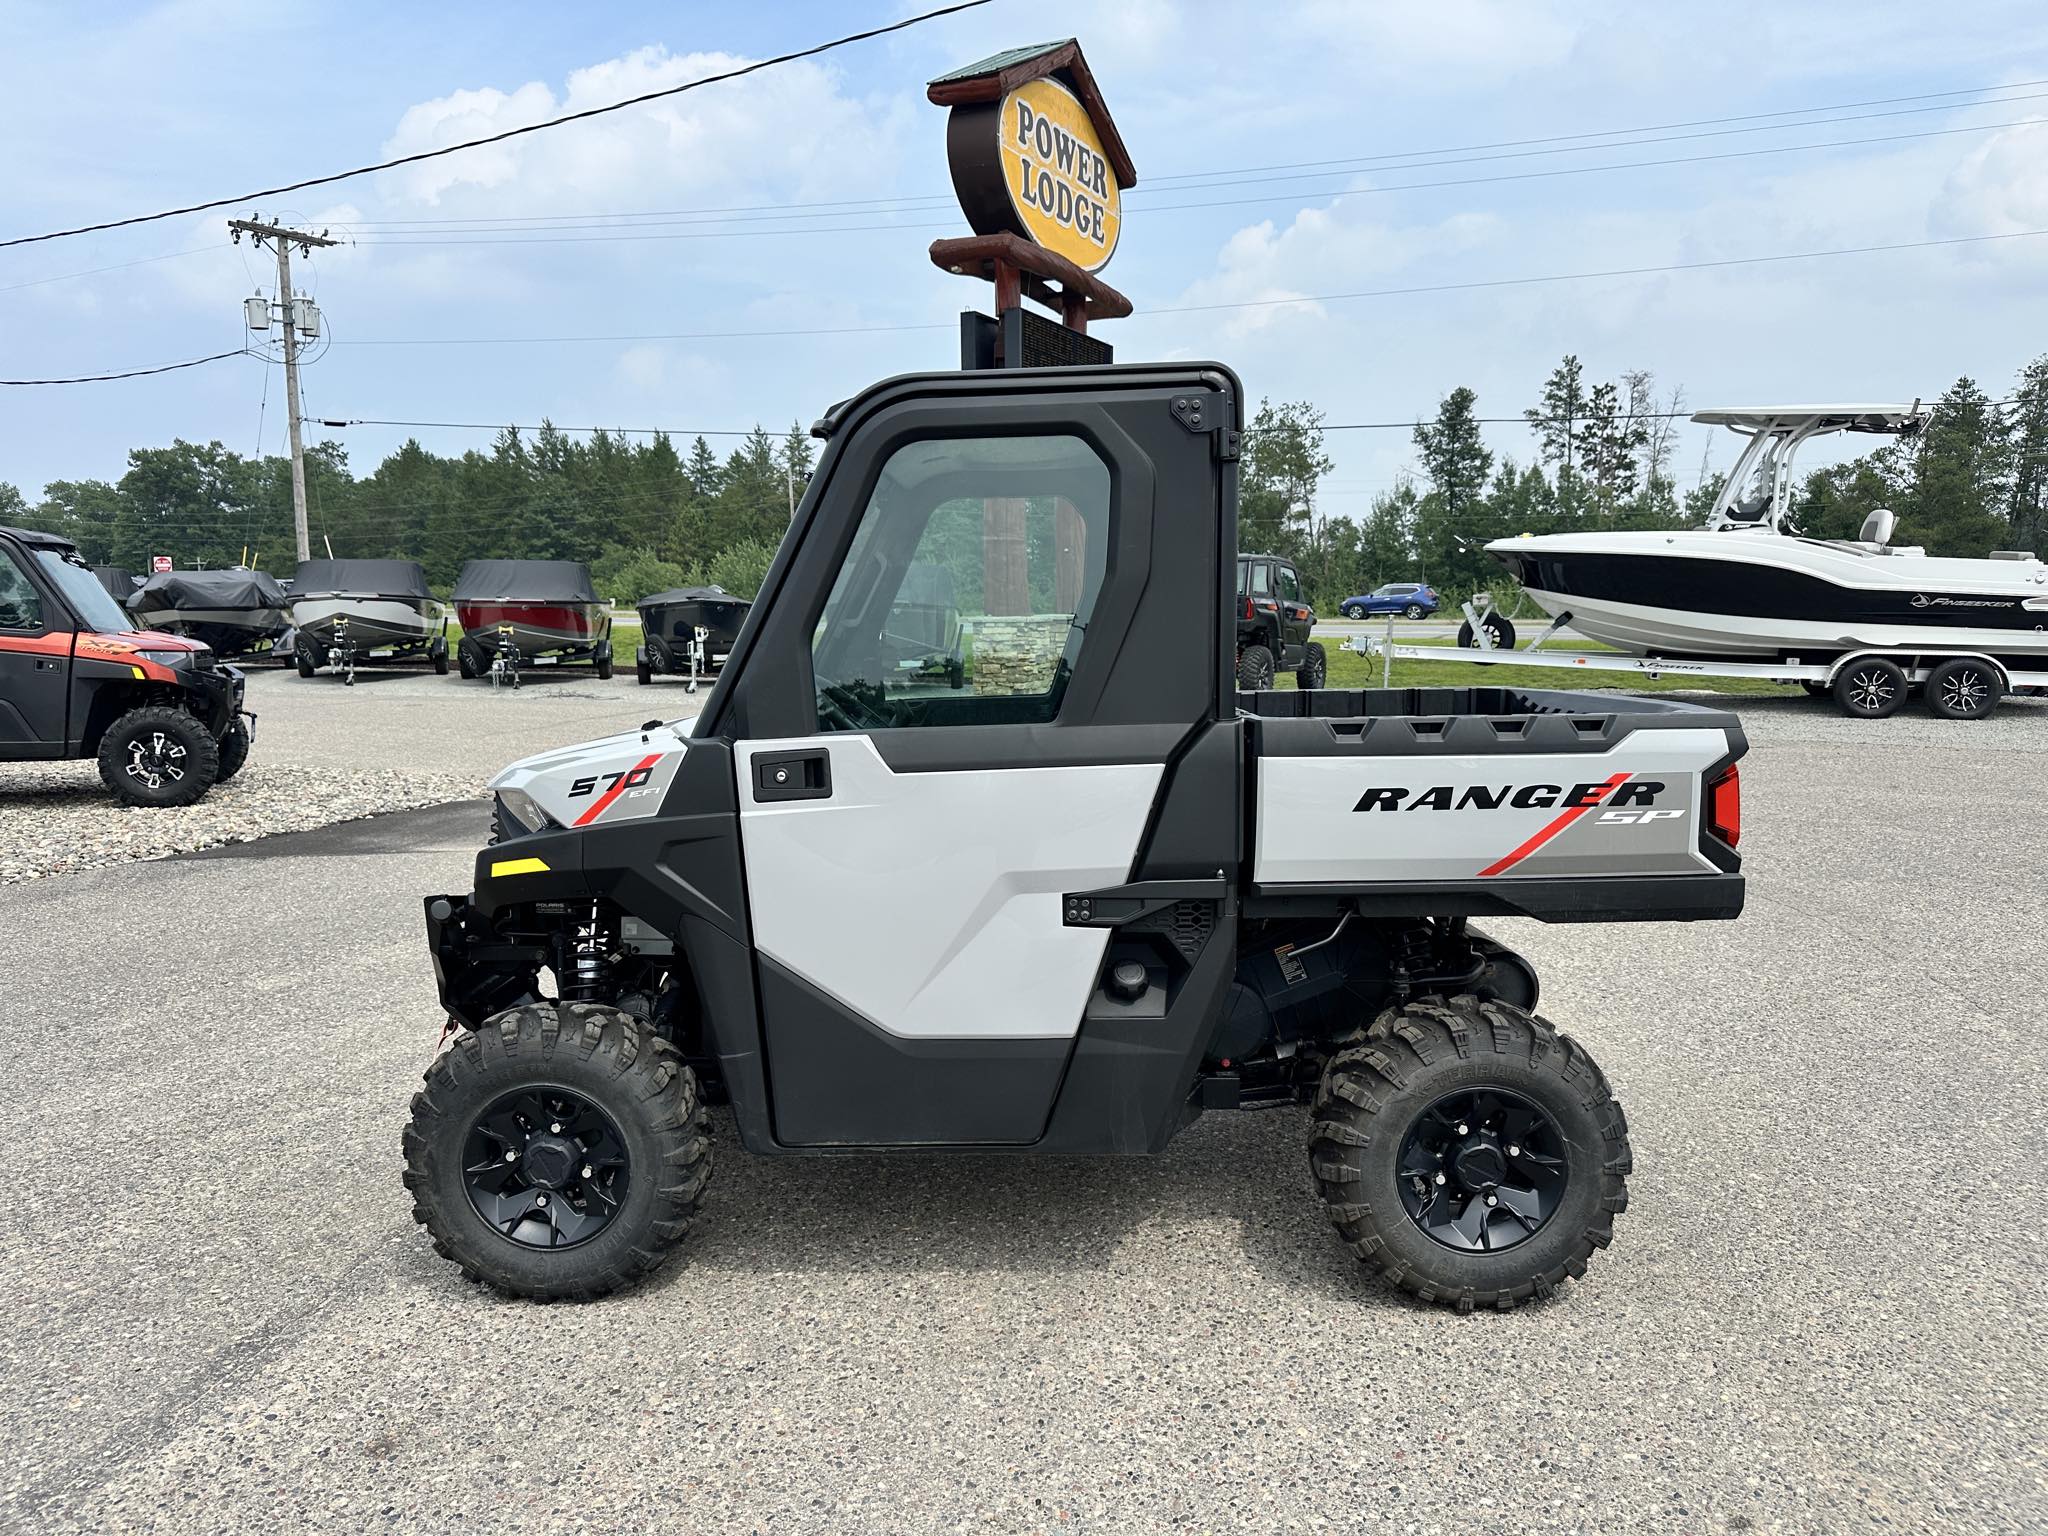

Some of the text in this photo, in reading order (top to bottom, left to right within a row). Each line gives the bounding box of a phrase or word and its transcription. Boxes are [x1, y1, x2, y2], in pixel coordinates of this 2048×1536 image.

[1017, 101, 1108, 199] POWER
[1022, 157, 1105, 243] LODGE
[1930, 597, 2015, 608] FINSEEKER
[568, 767, 654, 798] 570
[628, 787, 661, 799] EFI
[1352, 781, 1666, 812] RANGER
[1595, 809, 1686, 825] SP
